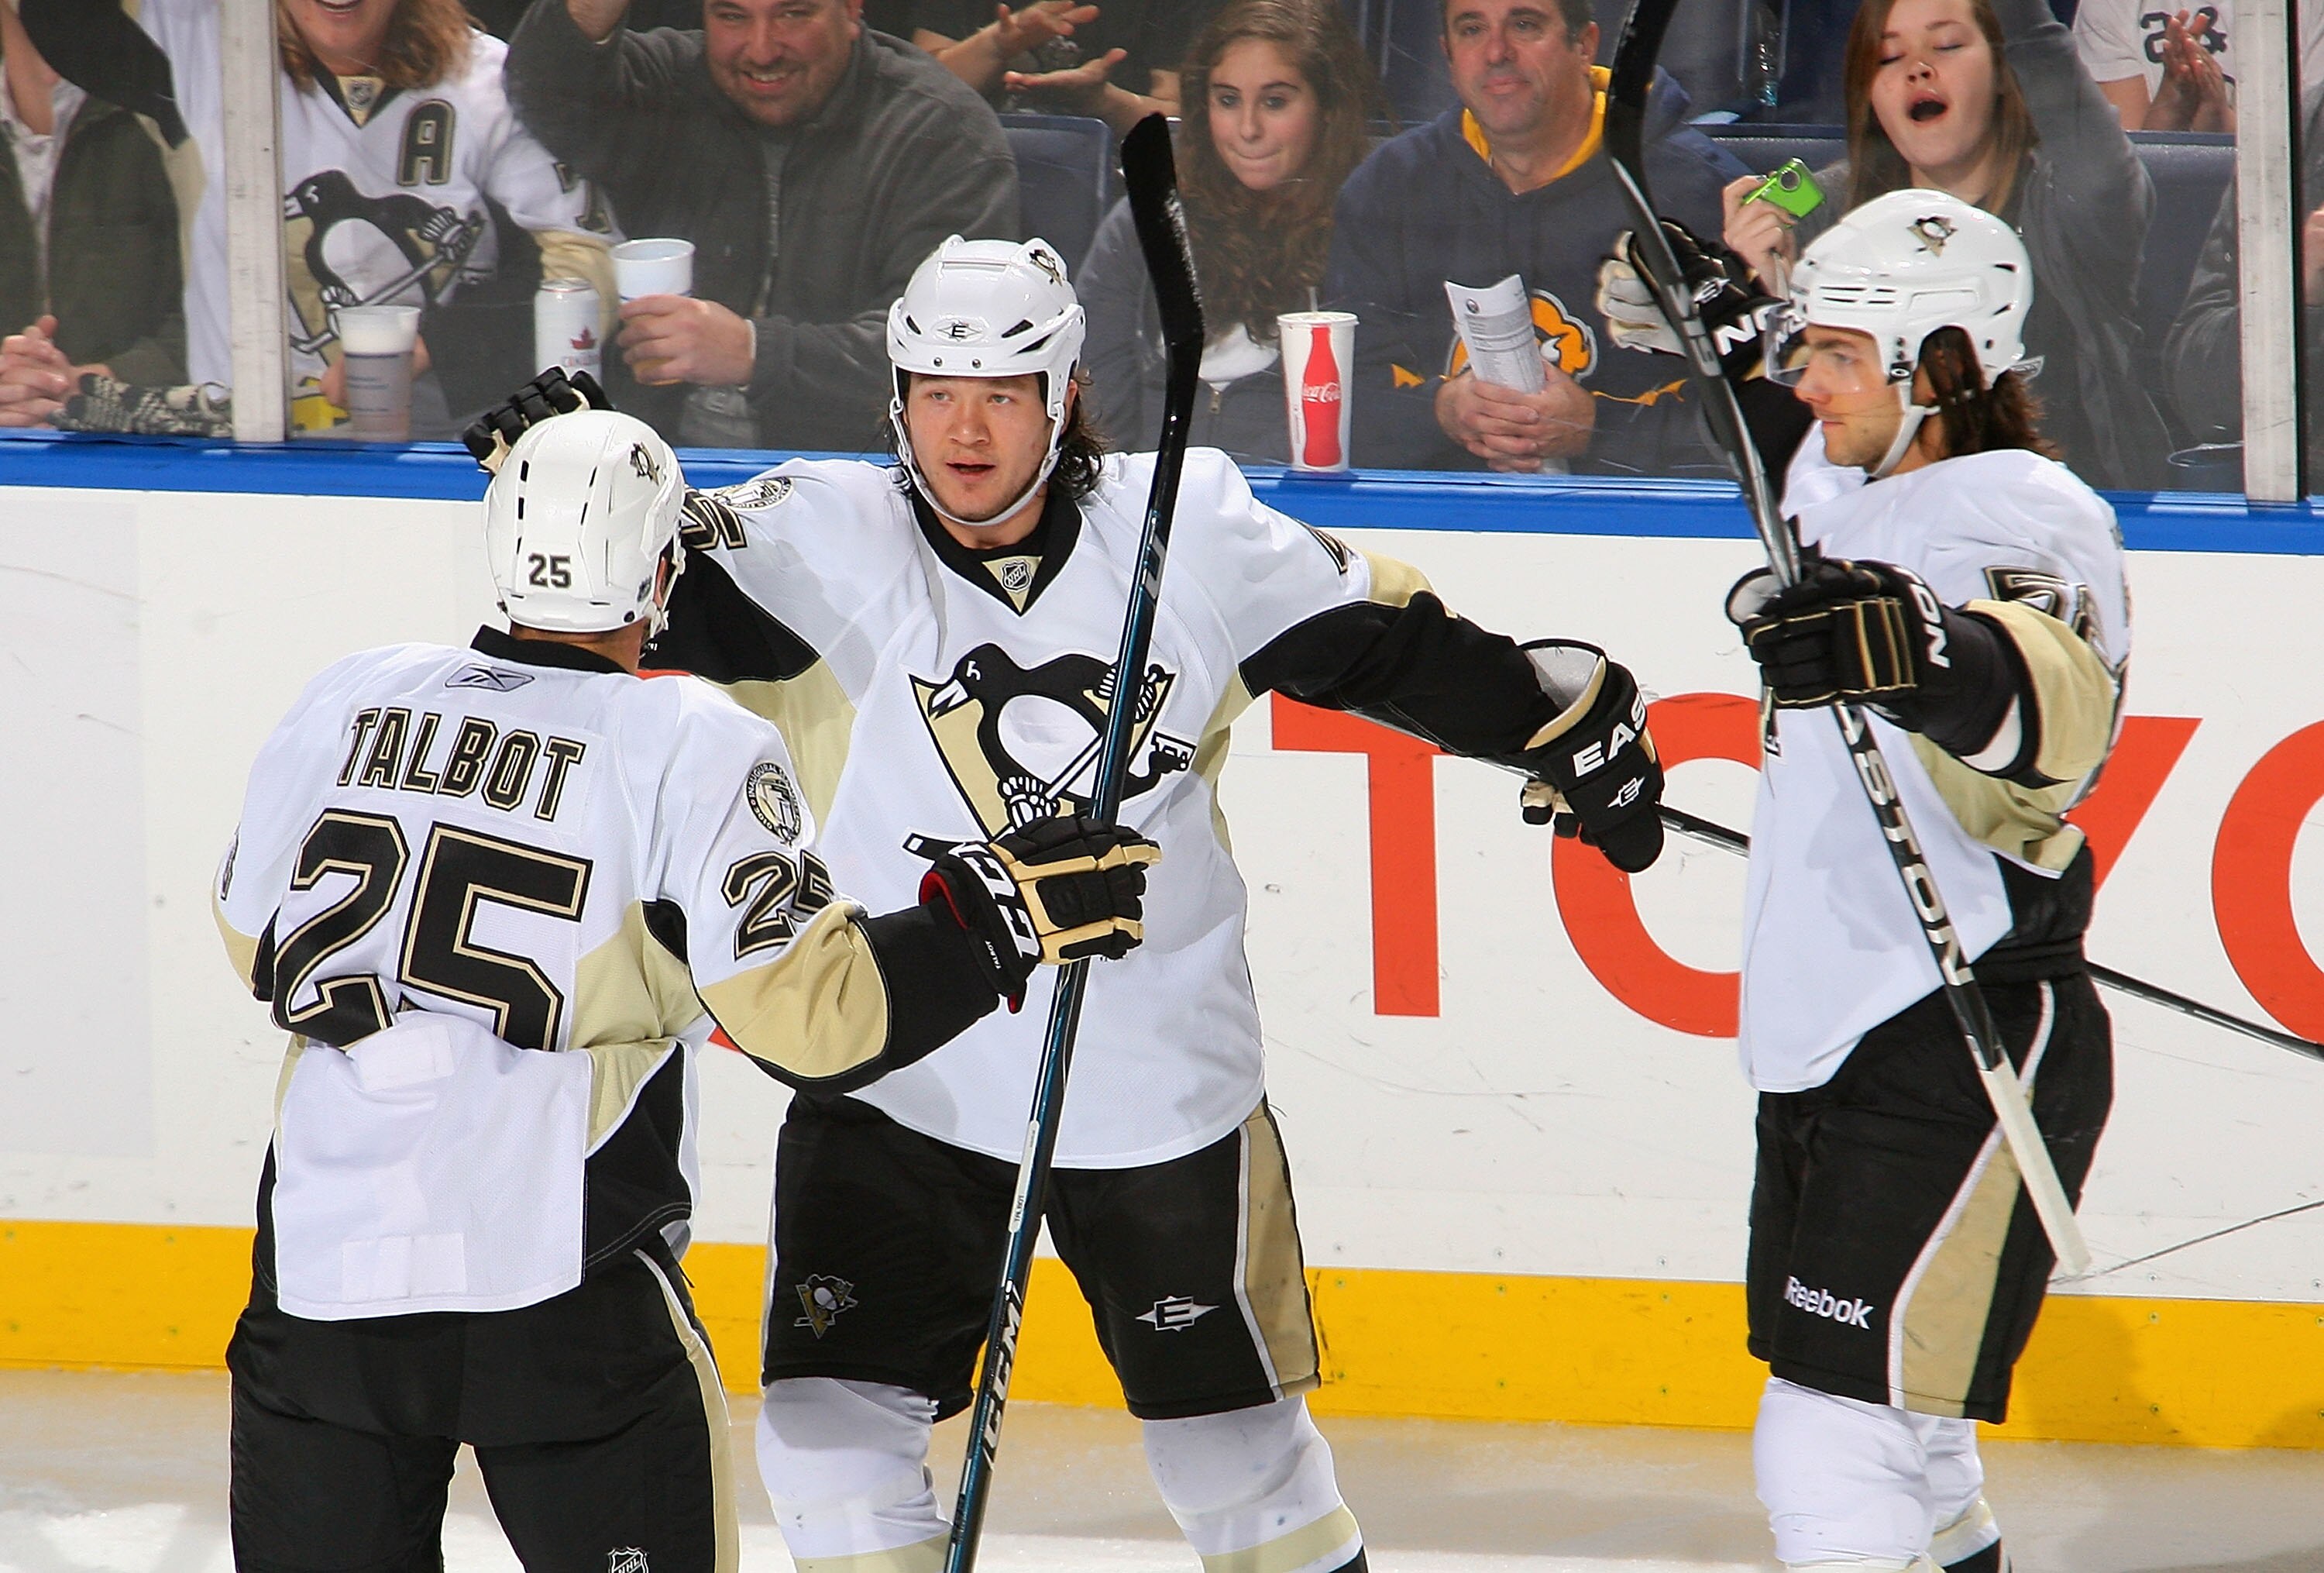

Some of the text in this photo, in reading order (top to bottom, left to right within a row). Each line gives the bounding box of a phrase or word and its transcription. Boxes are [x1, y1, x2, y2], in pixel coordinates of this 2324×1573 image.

[397, 98, 456, 186] A
[528, 552, 572, 588] 25
[336, 707, 586, 821] TALBOT
[271, 807, 593, 1052] 25
[985, 940, 1002, 969] TALBOT
[1784, 1275, 1874, 1330] Reebok
[982, 1302, 1023, 1454] CCM
